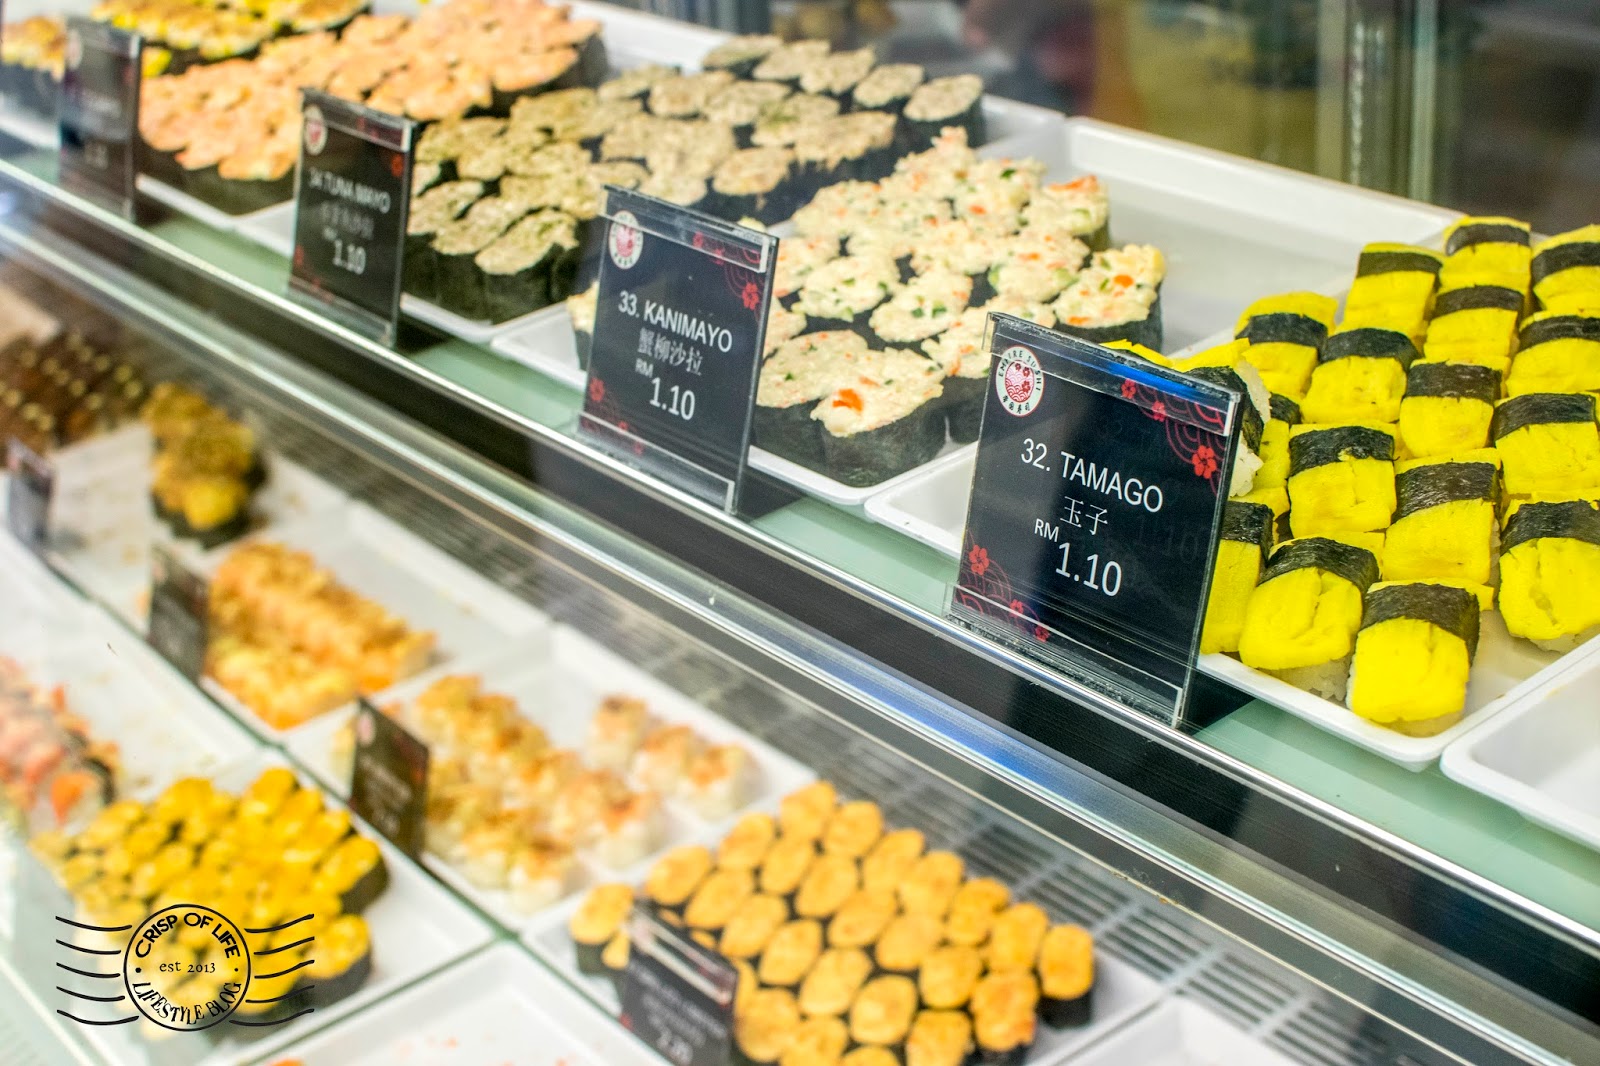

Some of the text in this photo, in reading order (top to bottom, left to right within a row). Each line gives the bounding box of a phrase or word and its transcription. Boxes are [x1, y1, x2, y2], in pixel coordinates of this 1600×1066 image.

[618, 290, 732, 353] 33. KANIMAYO
[635, 357, 654, 378] RM
[637, 327, 703, 376] 蟹柳沙拉
[649, 377, 695, 421] 1.10
[1021, 438, 1163, 513] 32. TAMAGO
[1034, 518, 1060, 542] RM
[1060, 496, 1108, 535] 玉子
[1055, 542, 1122, 596] 1.10
